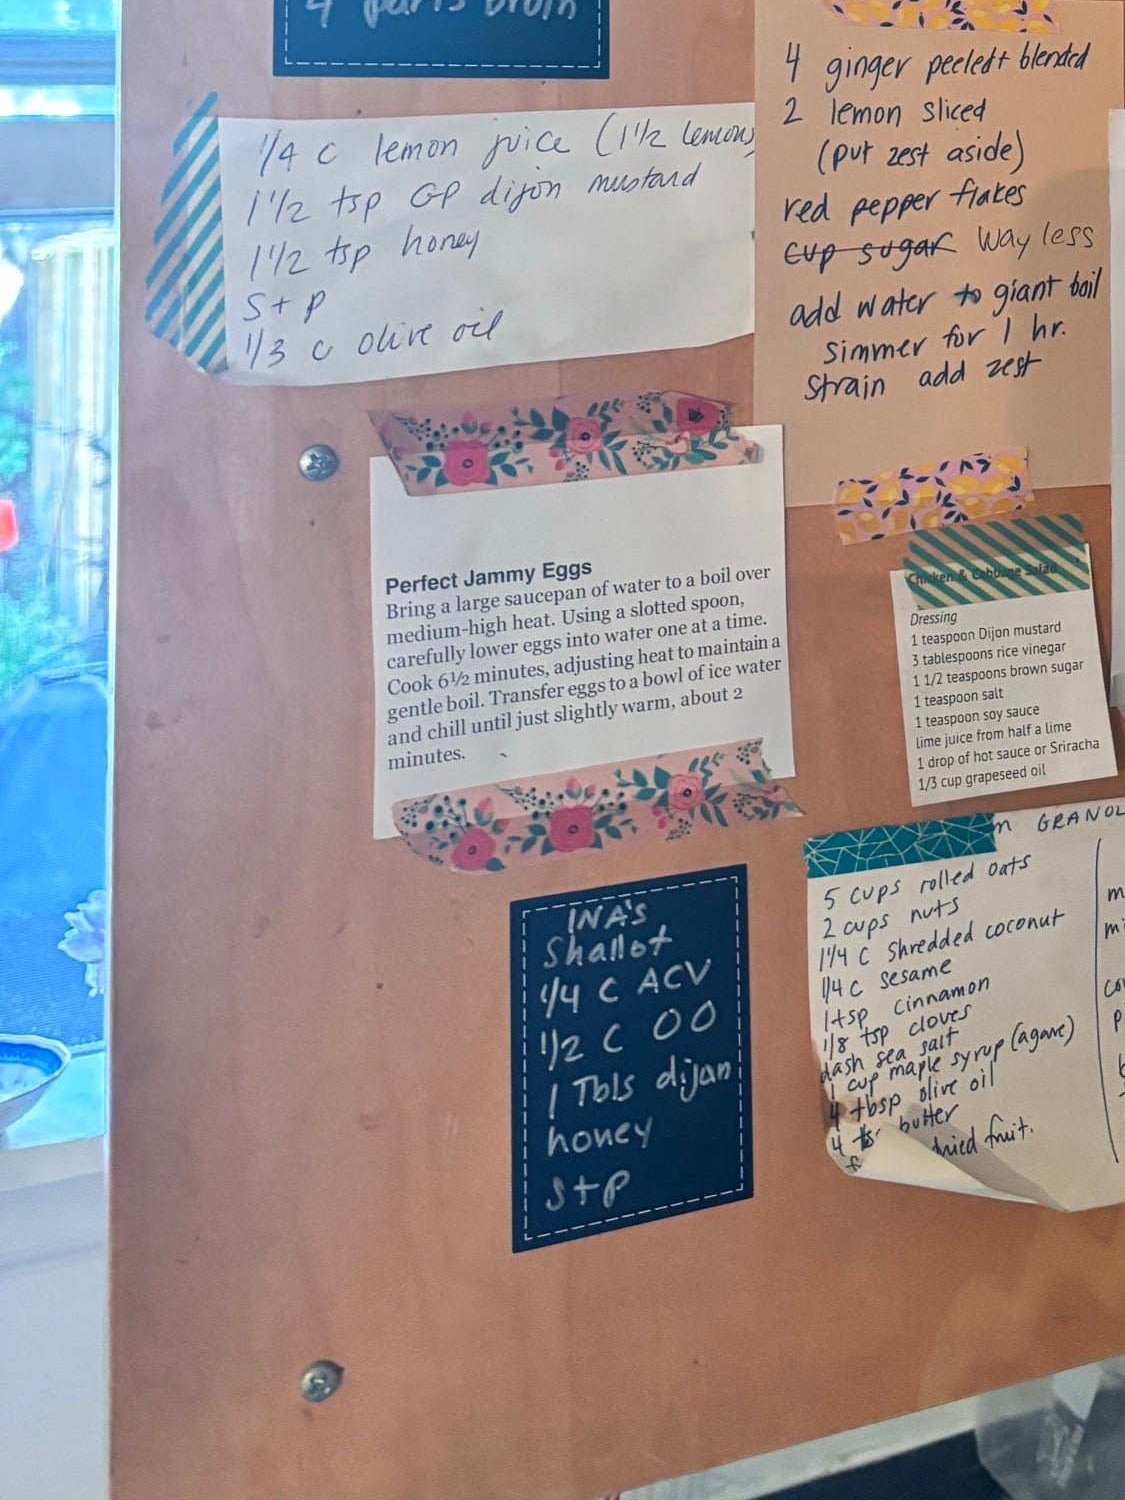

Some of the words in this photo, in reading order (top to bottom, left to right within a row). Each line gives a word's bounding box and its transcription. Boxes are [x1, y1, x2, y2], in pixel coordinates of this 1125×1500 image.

[784, 97, 803, 125] 2
[830, 96, 902, 127] lemon
[922, 97, 986, 124] sliced
[259, 132, 297, 177] 1/4
[374, 132, 459, 167] lemon
[482, 118, 571, 172] juice
[784, 192, 829, 223] red
[850, 187, 942, 227] pepper
[949, 178, 1027, 209] flakes
[246, 330, 285, 370] 1/3
[357, 323, 429, 356] olive
[452, 308, 505, 341] oil
[823, 335, 928, 365] simmer
[943, 324, 985, 354] for
[1030, 313, 1067, 340] hr.
[385, 572, 458, 595] Perfect
[463, 564, 536, 586] Jammy
[542, 560, 593, 581] Eggs
[385, 601, 436, 621] Bring
[440, 602, 451, 614] a
[455, 594, 501, 616] large
[504, 586, 587, 607] saucepan
[591, 584, 610, 599] of
[612, 576, 661, 595] water
[665, 576, 682, 591] to
[685, 576, 696, 588] a
[699, 568, 732, 586] boil
[734, 565, 771, 583] over
[910, 611, 958, 626] Dressing
[925, 691, 979, 708] teaspoon
[982, 687, 1004, 701] salt
[918, 776, 938, 791] 1/3
[941, 774, 962, 789] cup
[965, 768, 1027, 787] grapeseed
[1030, 764, 1047, 777] oil
[823, 886, 837, 911] 5
[849, 878, 901, 907] cups
[919, 870, 975, 896] rolled
[988, 854, 1032, 878] oats
[567, 899, 647, 934] INA'S
[540, 976, 580, 1019] 1/4
[637, 958, 712, 995] ACV
[548, 1115, 654, 1157] honey
